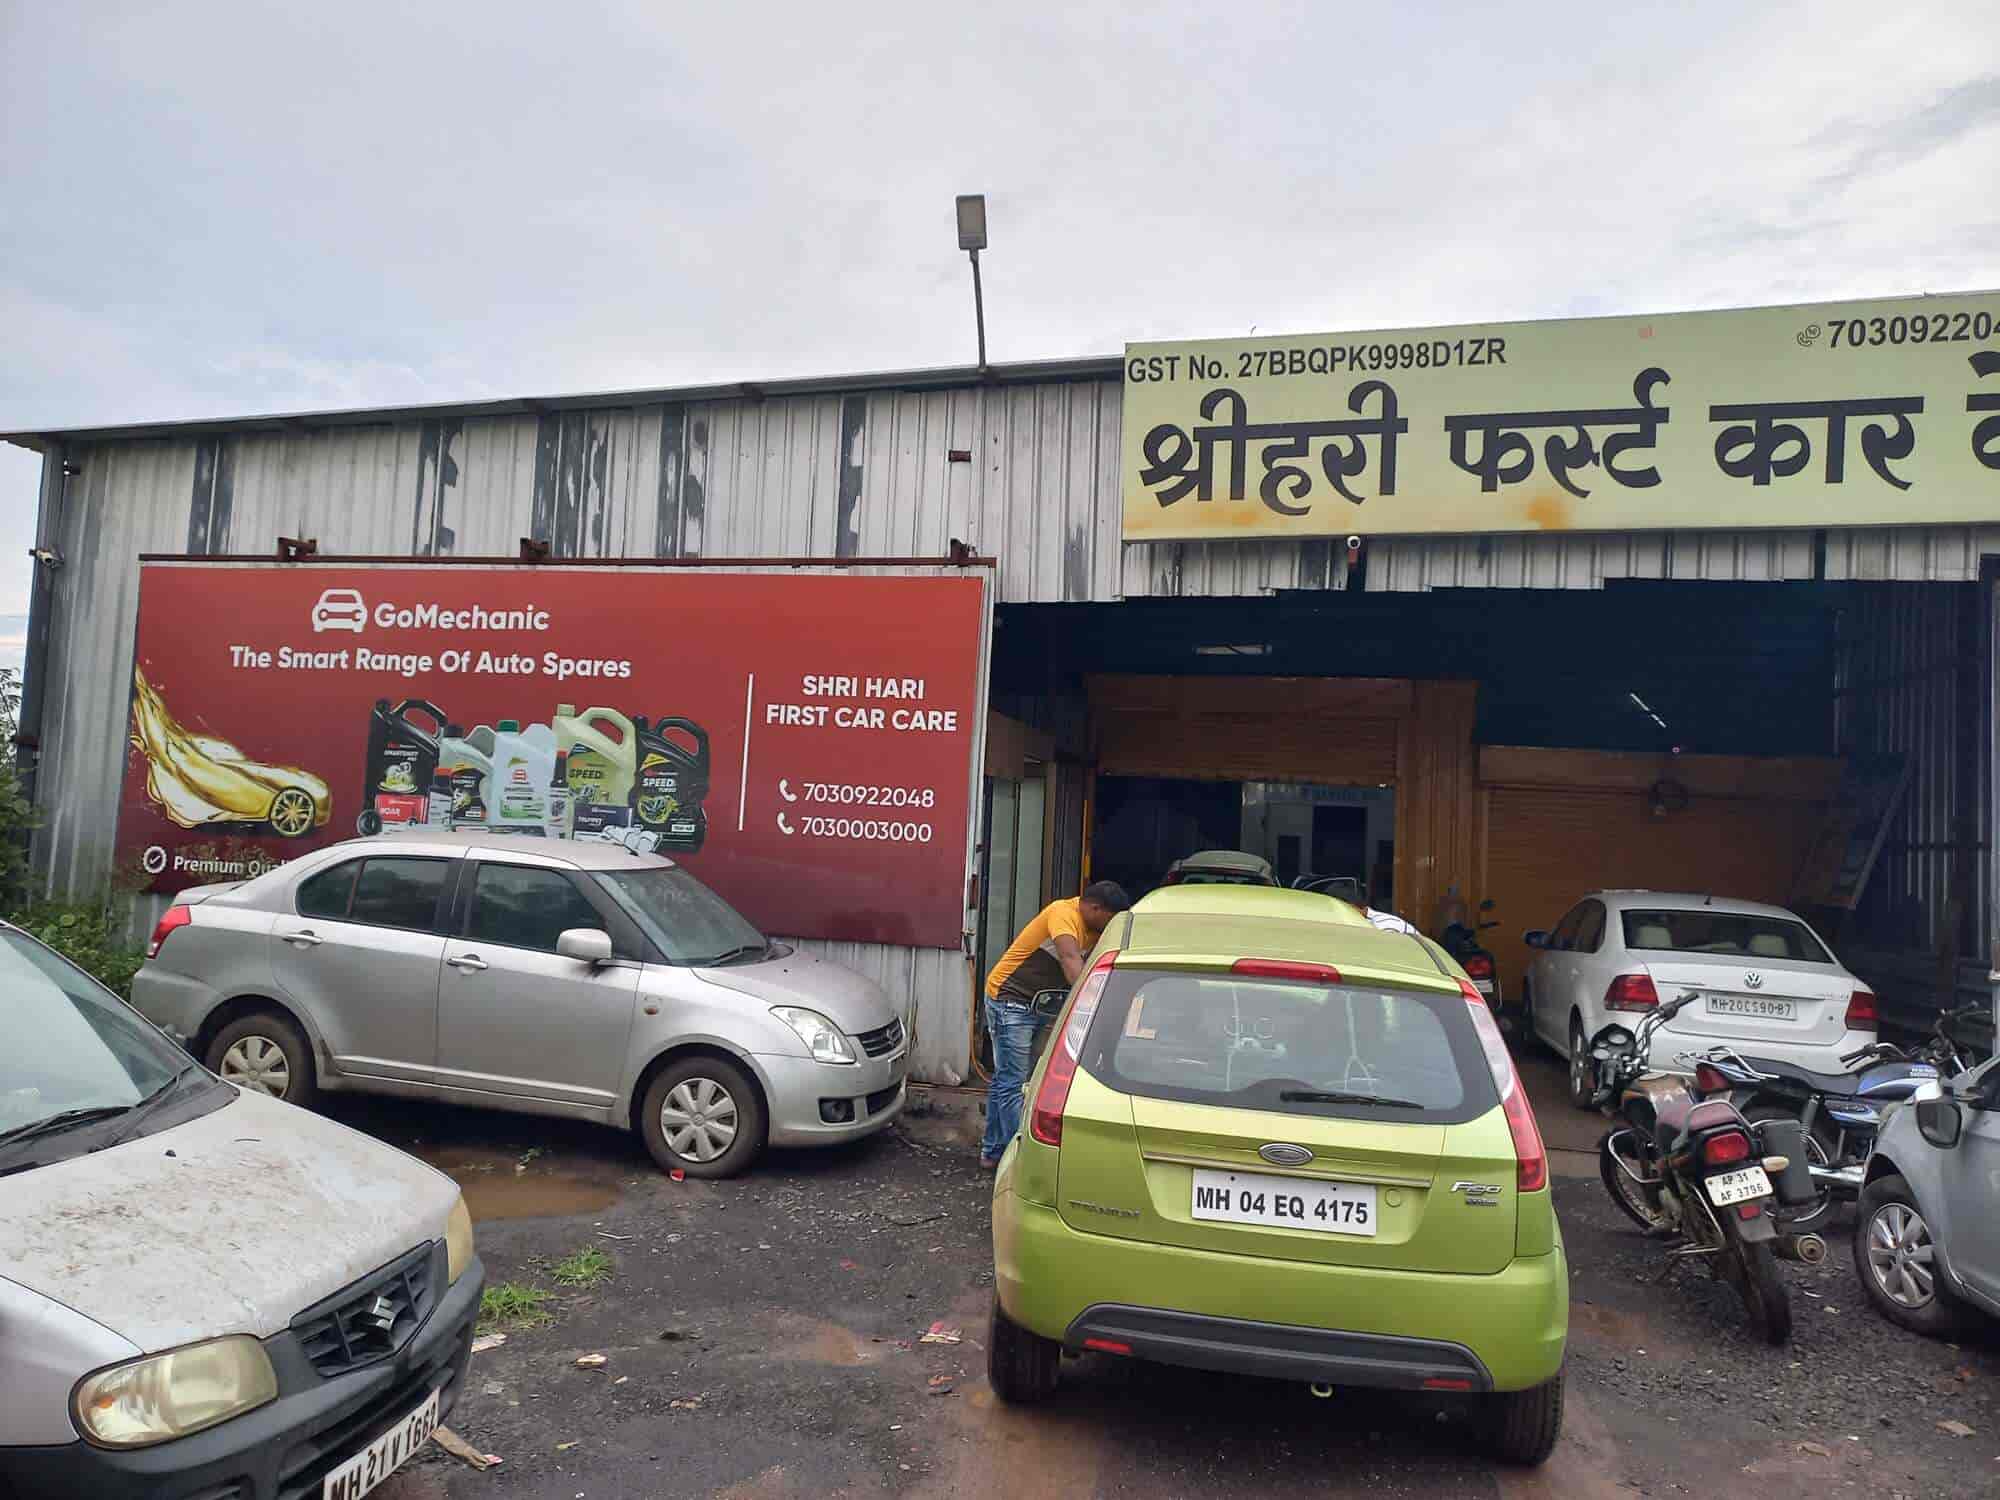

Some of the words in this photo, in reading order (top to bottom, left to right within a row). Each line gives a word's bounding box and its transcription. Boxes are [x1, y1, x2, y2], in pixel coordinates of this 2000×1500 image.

[1128, 356, 1180, 383] GST
[1189, 355, 1229, 380] No.
[1239, 338, 1507, 378] 27BBQPK9998D1ZR
[1139, 380, 1408, 516] श्रीहरी
[1709, 396, 1925, 490] कार
[374, 604, 550, 631] GoMechanic
[230, 645, 271, 669] The
[278, 646, 348, 670] Smart
[356, 648, 432, 677] Range
[439, 650, 470, 673] Of
[475, 651, 535, 676] Auto
[542, 652, 631, 680] Spares
[803, 675, 857, 697] SHRI
[865, 677, 924, 699] HARI
[766, 704, 829, 726] FIRST
[835, 708, 884, 729] CAR
[892, 710, 957, 731] CARE
[803, 783, 934, 808] 7030922048
[801, 817, 932, 842] 7030003000
[173, 856, 243, 874] Premium
[1196, 1186, 1231, 1211] MH
[1240, 1191, 1266, 1215] 04
[1275, 1195, 1305, 1220] EQ
[1314, 1199, 1369, 1225] 4175
[330, 1464, 362, 1500] MH
[367, 1441, 387, 1488] 21
